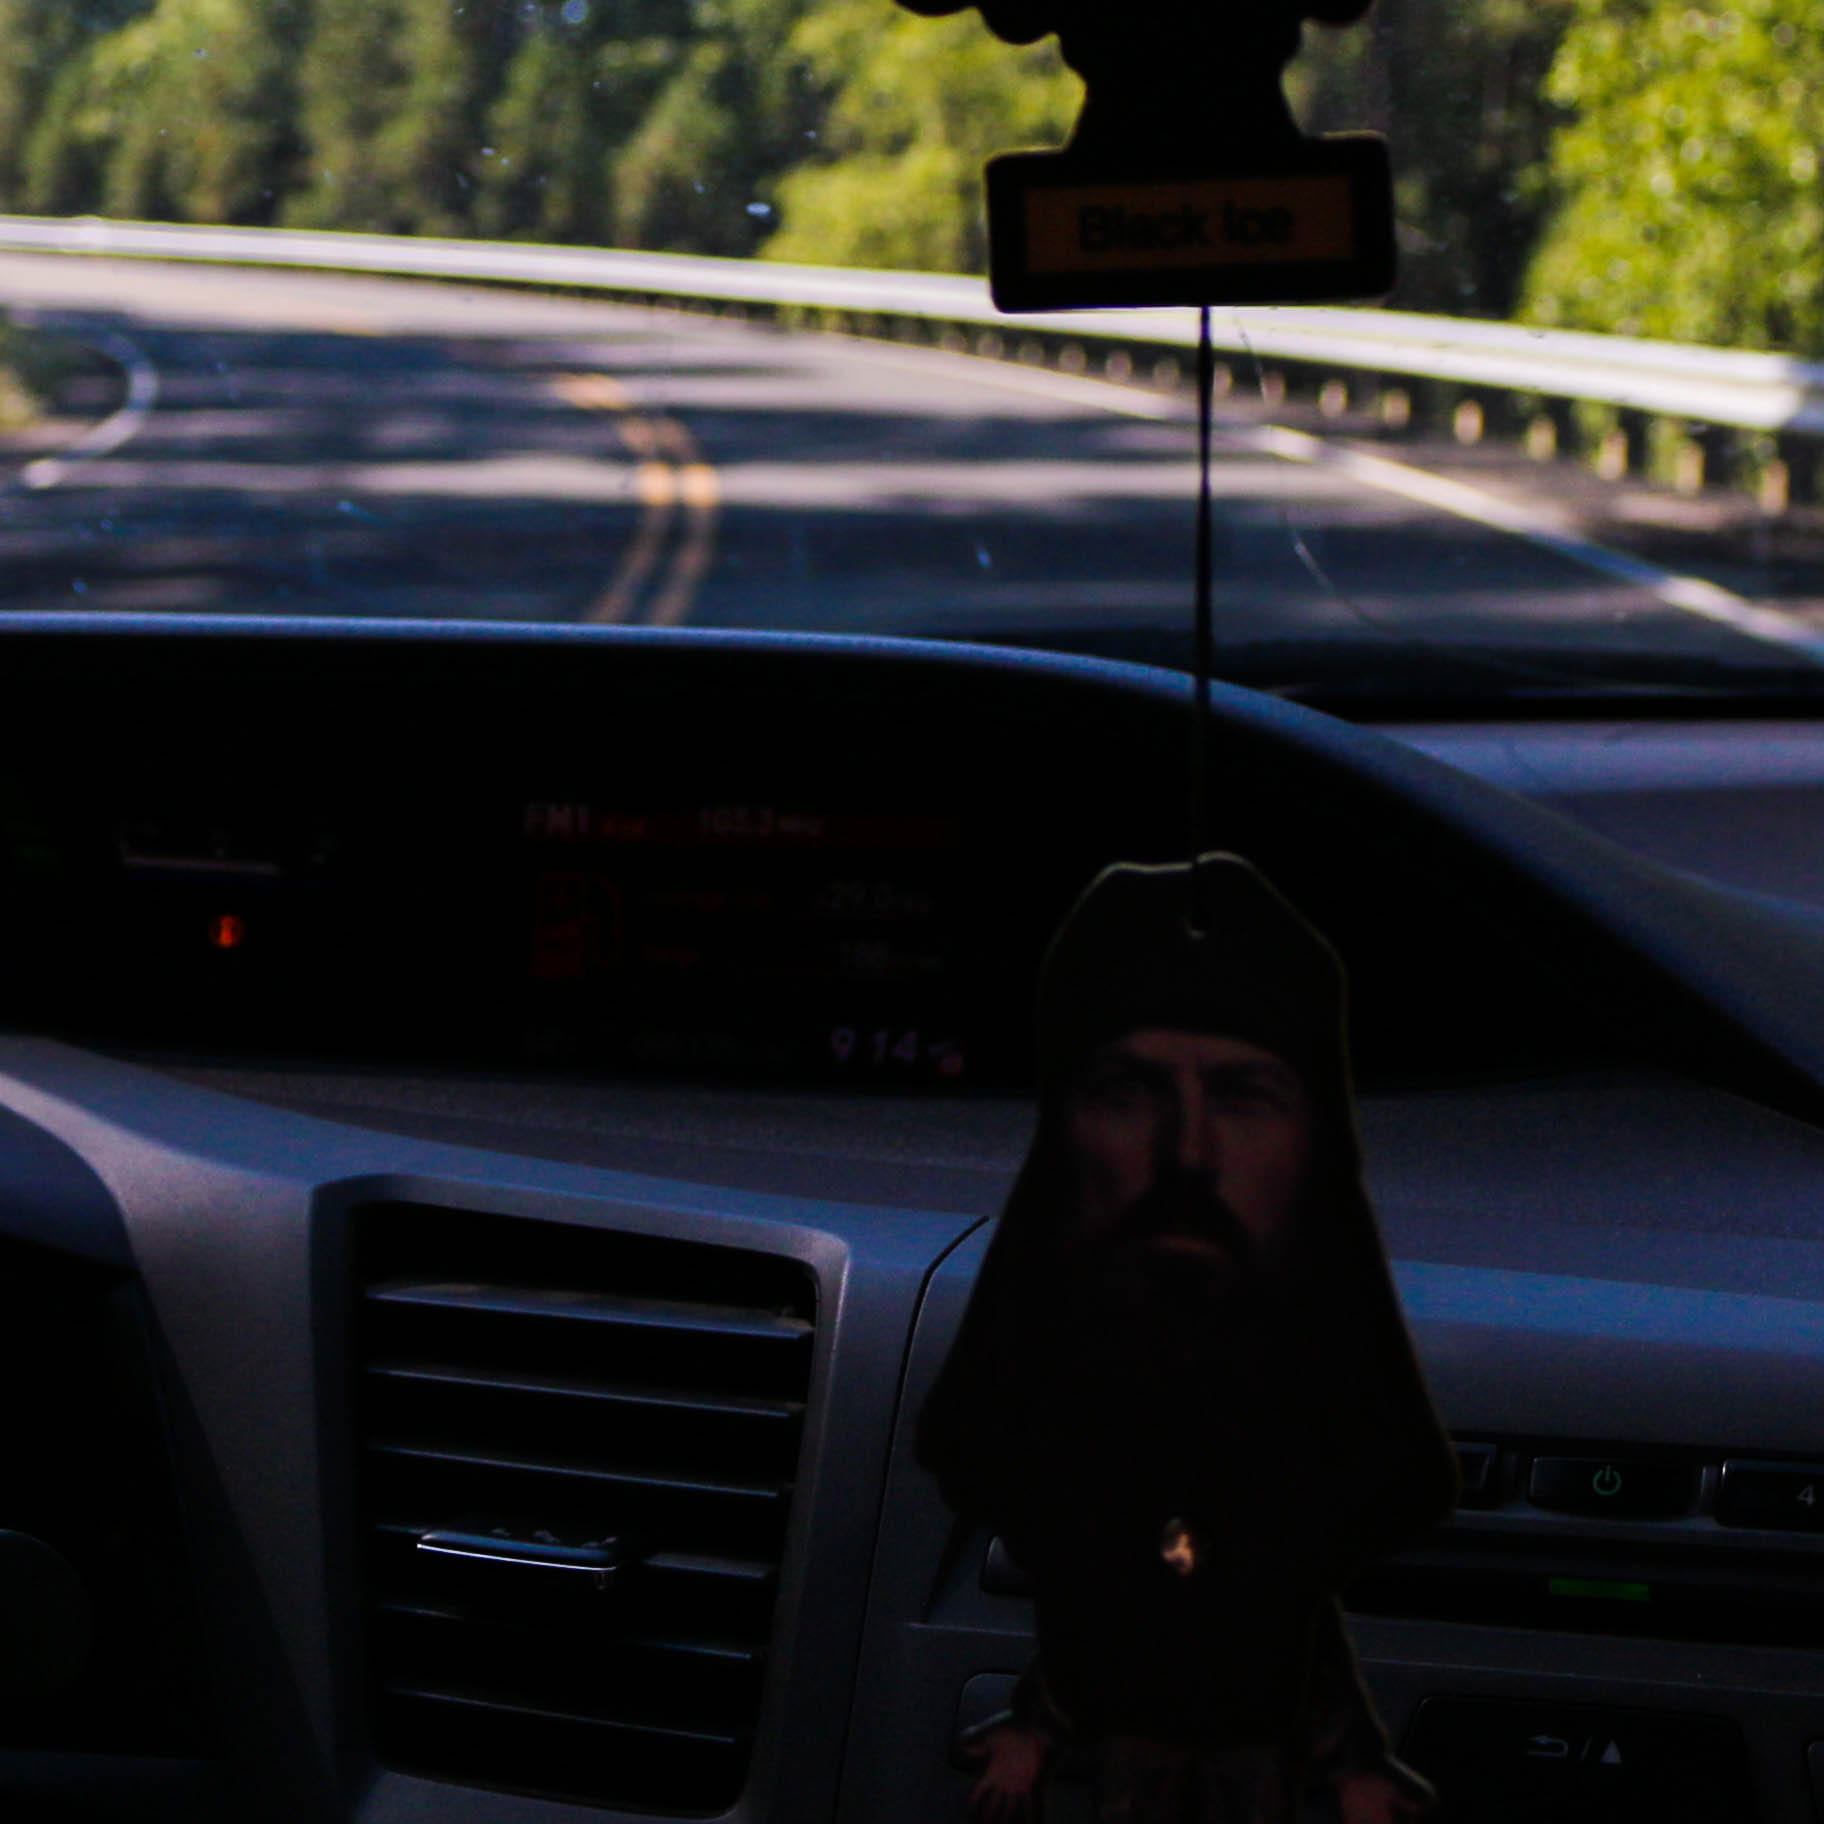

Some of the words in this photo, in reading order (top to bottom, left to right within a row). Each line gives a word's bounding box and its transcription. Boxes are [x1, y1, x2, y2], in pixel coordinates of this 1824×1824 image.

[1080, 203, 1212, 253] Black
[1224, 199, 1295, 246] Ice
[1795, 1482, 1817, 1509] 4
